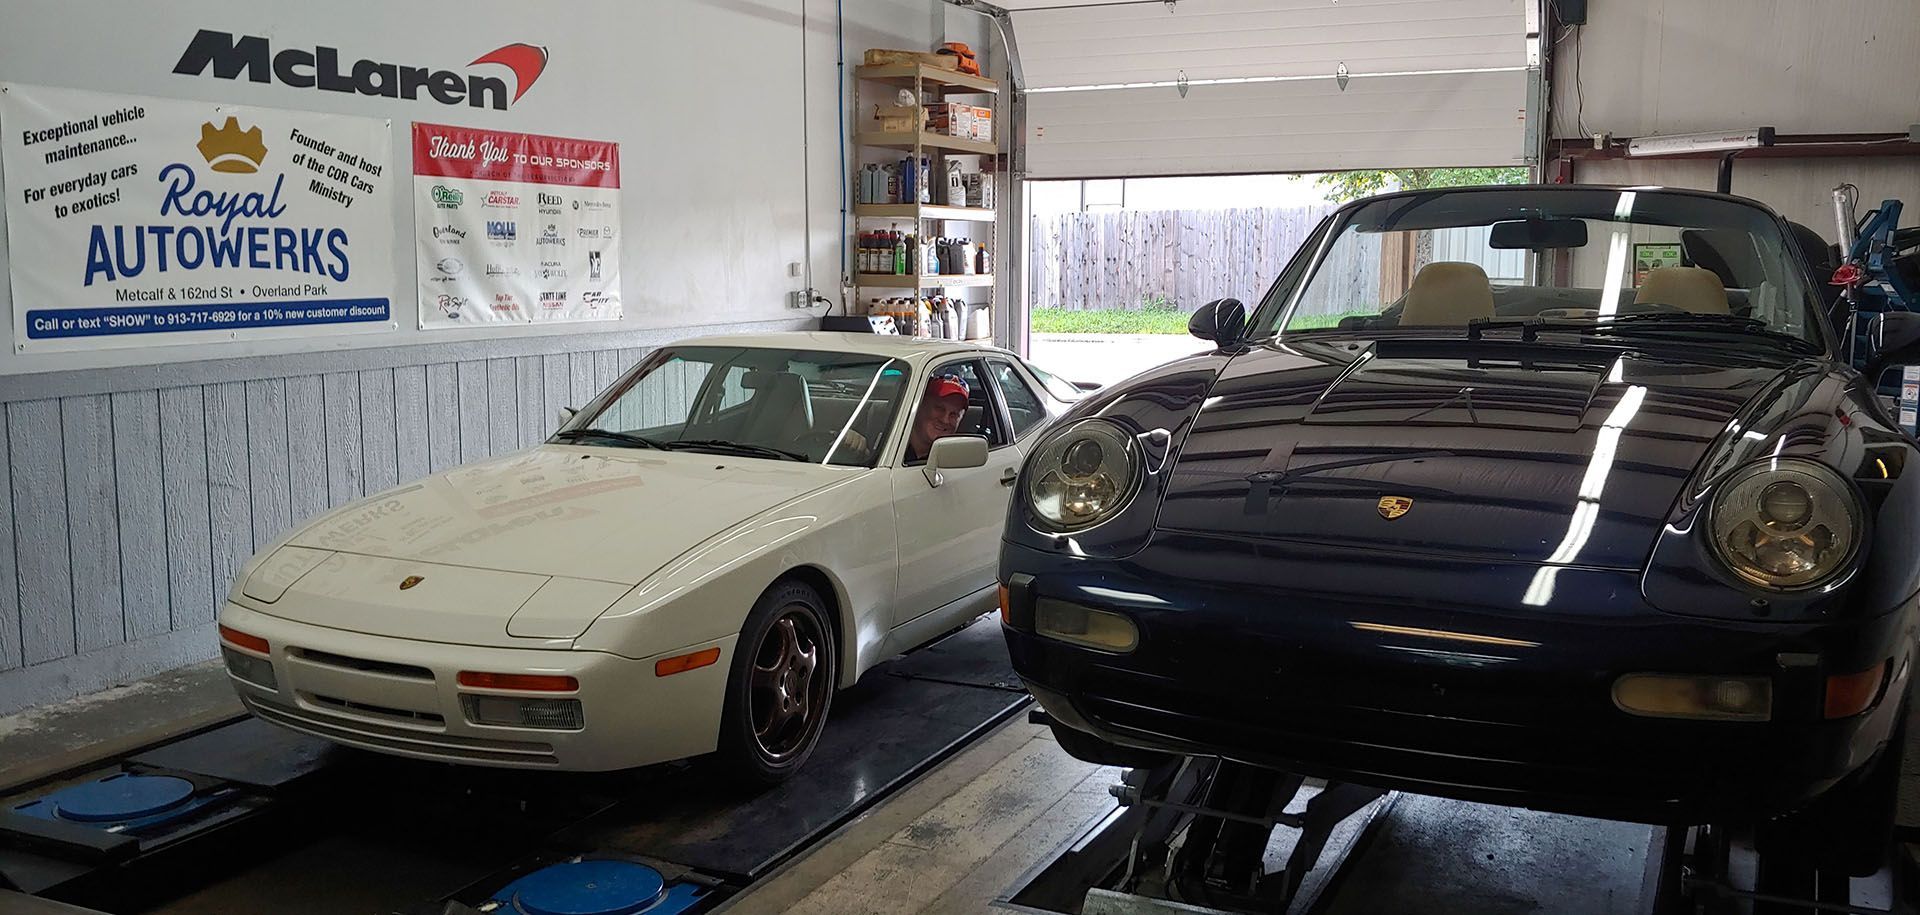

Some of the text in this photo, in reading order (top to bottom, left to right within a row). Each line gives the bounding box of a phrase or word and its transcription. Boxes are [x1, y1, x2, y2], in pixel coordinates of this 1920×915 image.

[171, 29, 508, 111] McLaren
[22, 106, 145, 145] Exceptional vehicle
[45, 134, 137, 164] maintenance...
[289, 128, 382, 177] Founder and host
[429, 135, 611, 171] Thank You TO OUR SPONSORS
[23, 163, 138, 204] For everyday cars
[292, 153, 374, 194] of the COR Cars
[55, 187, 121, 219] to exotics!
[158, 163, 287, 237] Royal
[308, 179, 353, 208] Ministry
[538, 192, 563, 206] REED
[83, 224, 349, 288] AUTOWERKS
[115, 284, 328, 301] Metcalf & 162nd St Overland Park
[34, 318, 59, 331] Call
[62, 318, 75, 329] or
[78, 316, 101, 328] text
[154, 314, 165, 325] to
[167, 309, 236, 325] 913-717-6929
[238, 309, 252, 322] for
[253, 313, 261, 321] a
[262, 308, 283, 320] 10%
[285, 310, 304, 319] new
[306, 307, 348, 319] customer
[349, 305, 386, 316] discount
